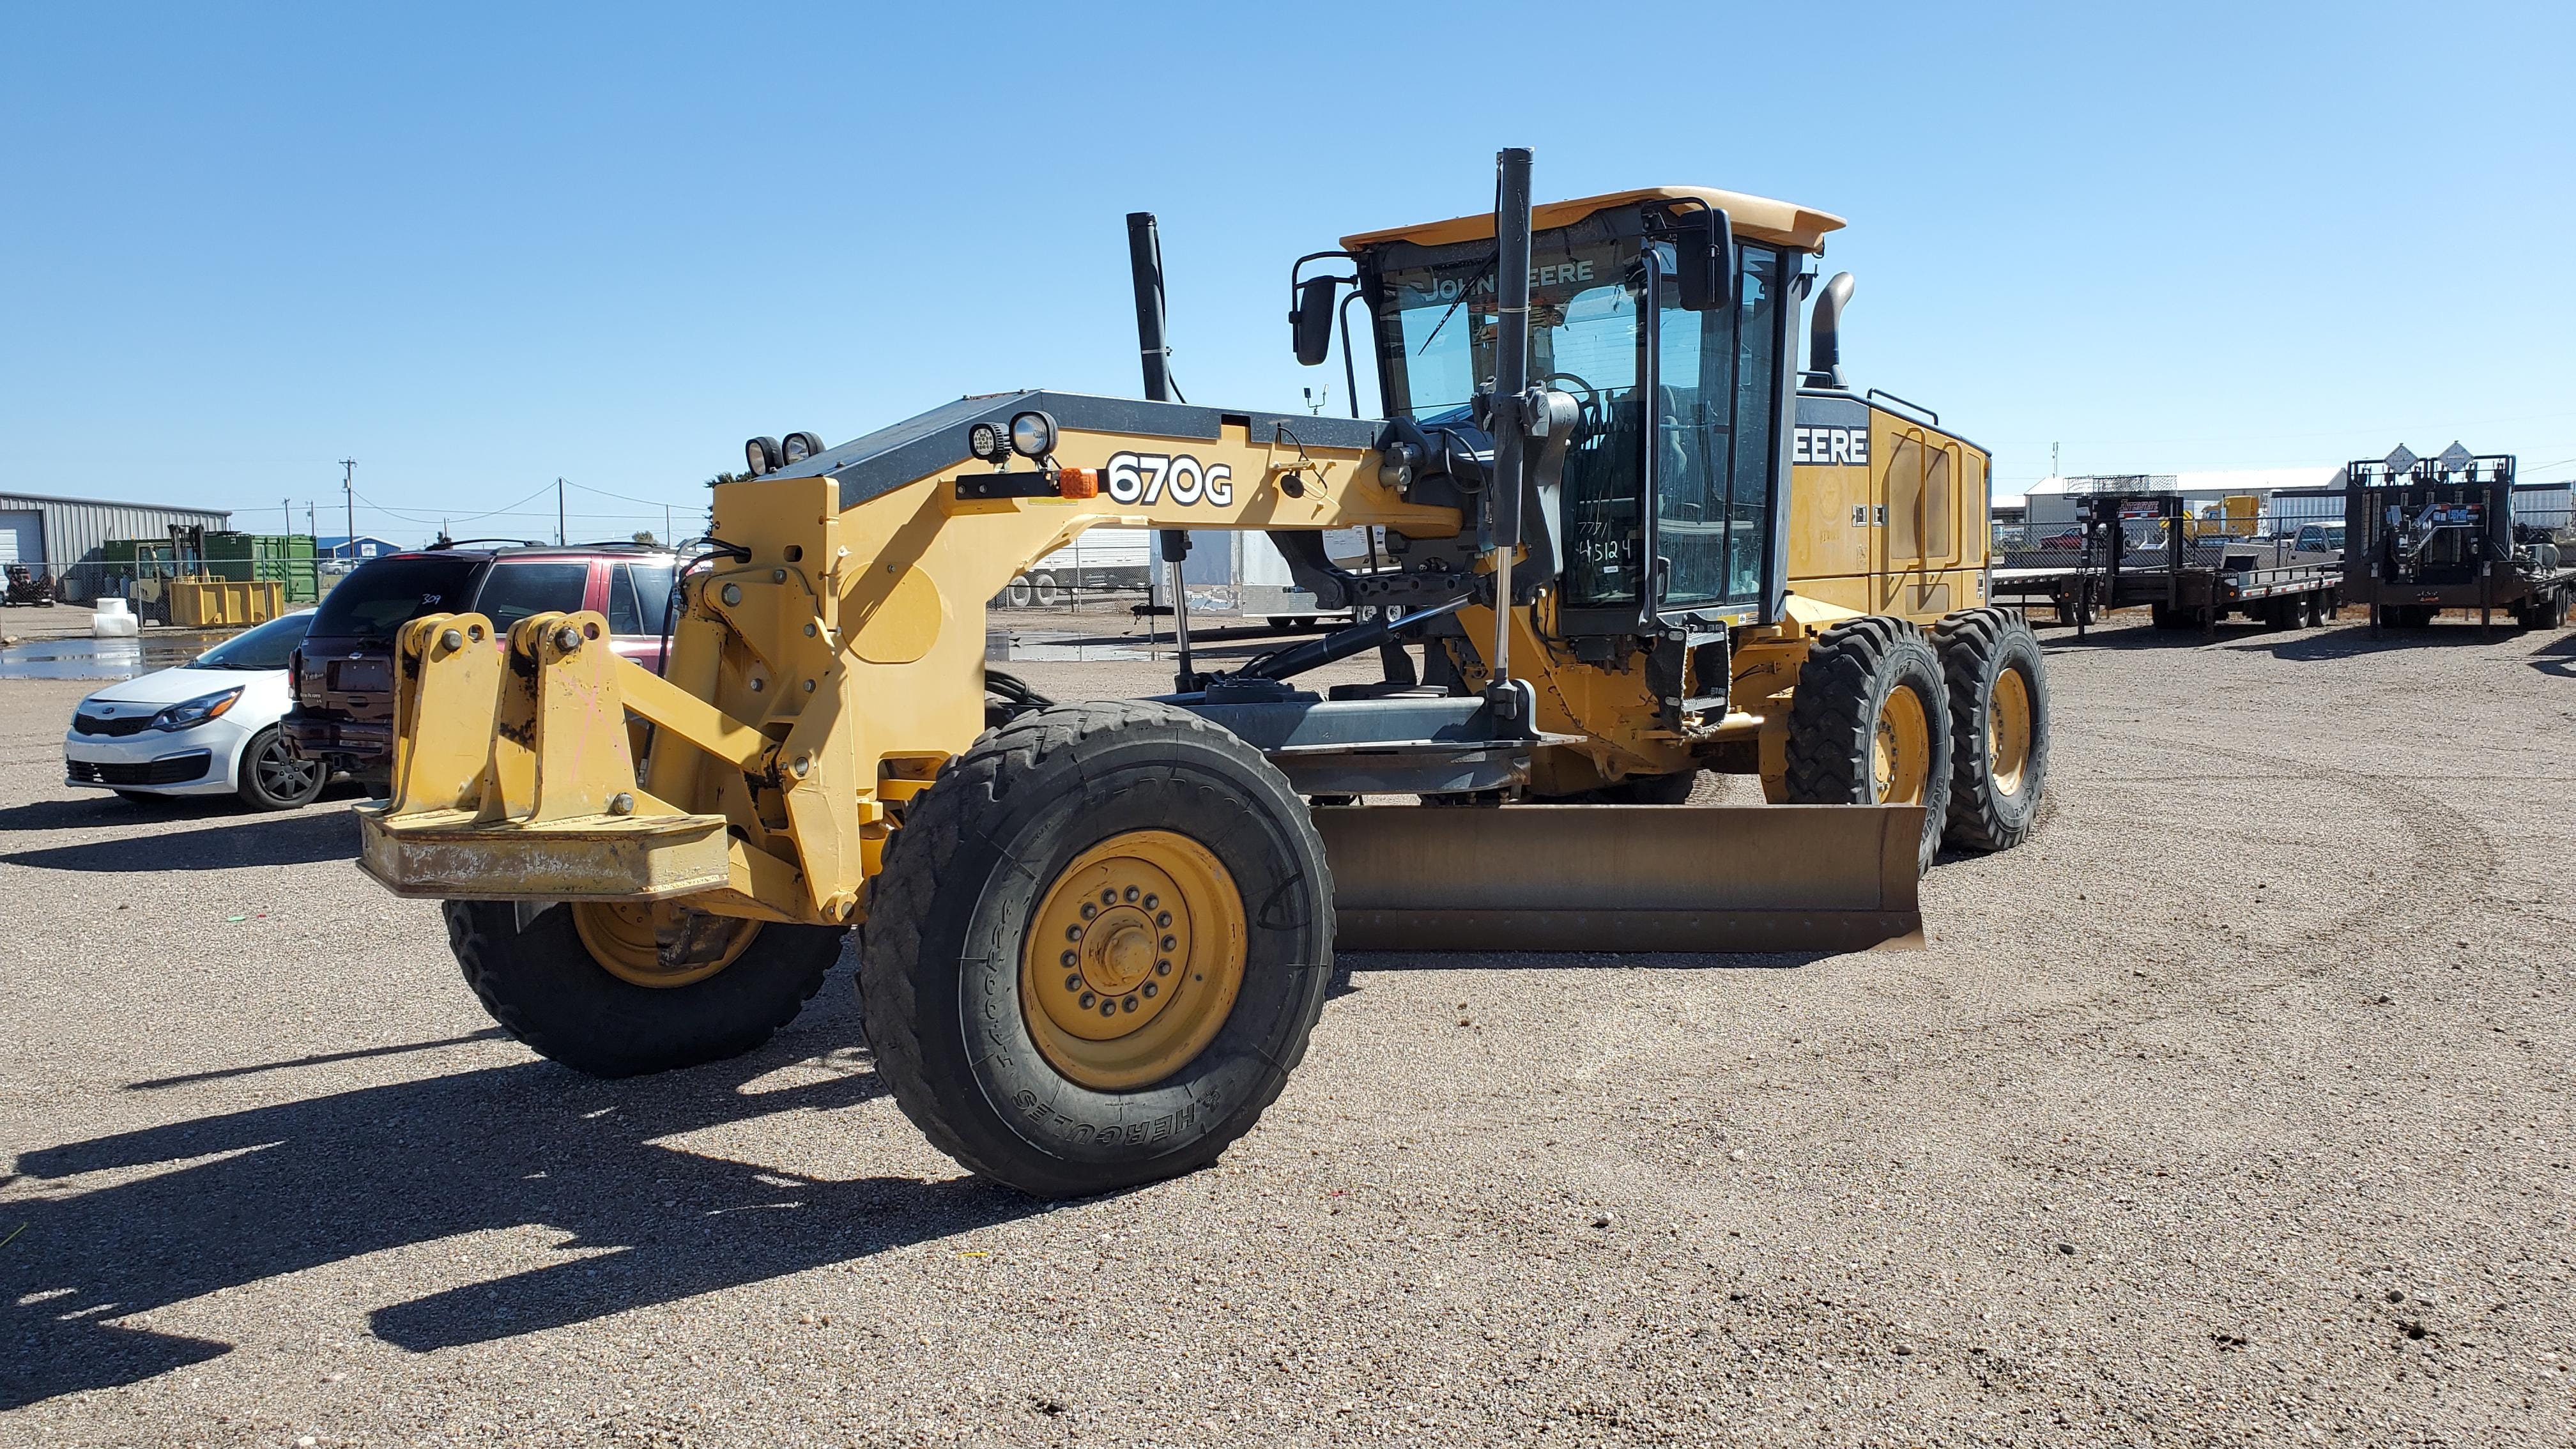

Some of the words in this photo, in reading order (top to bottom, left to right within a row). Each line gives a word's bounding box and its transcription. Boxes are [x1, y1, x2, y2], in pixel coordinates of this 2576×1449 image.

[1424, 274, 1495, 302] JOHN
[1529, 260, 1594, 288] EERE
[1793, 428, 1867, 463] EERE
[1107, 451, 1232, 507] 670G
[422, 594, 441, 605] 309
[1011, 1089, 1195, 1146] HERCULES
